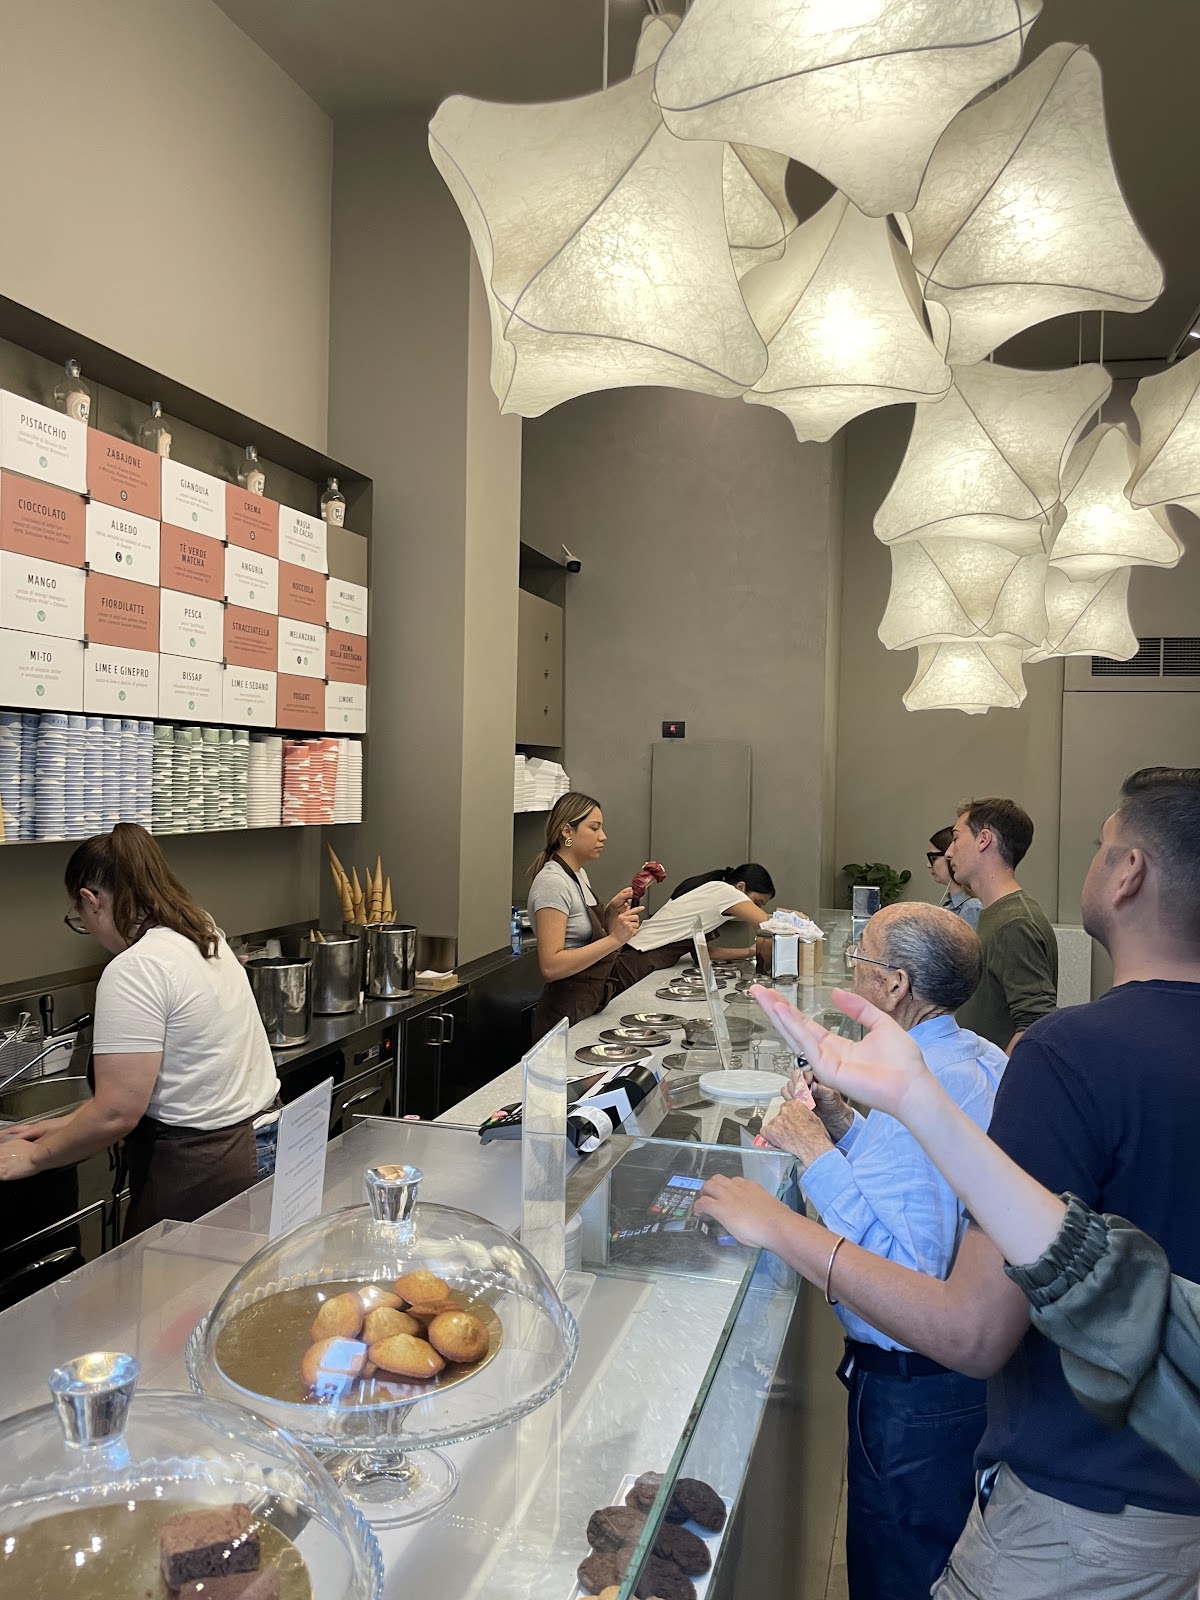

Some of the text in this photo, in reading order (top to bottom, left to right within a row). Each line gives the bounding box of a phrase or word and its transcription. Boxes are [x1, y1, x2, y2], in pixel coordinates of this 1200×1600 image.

[21, 414, 67, 440] PISTACCHIO
[107, 447, 141, 468] ZABAJONE
[181, 478, 209, 496] GIANDUIA
[18, 499, 66, 520] CIOCCOLATO
[244, 502, 261, 515] CREMA
[111, 520, 137, 535] ALBEDO
[296, 519, 310, 530] MASSA
[300, 528, 313, 539] CACAO
[189, 546, 207, 559] VERDE
[182, 554, 204, 567] MATCHA
[241, 562, 263, 575] ANGURIA
[27, 574, 57, 589] MANGO
[292, 582, 314, 594] NOCCIOLA
[101, 597, 145, 615] FIORDILATTE
[184, 608, 202, 619] PESCA
[232, 622, 269, 636] STRACCIATELLA
[289, 630, 316, 642] MELANZANA
[30, 650, 52, 662] MI-TO
[95, 662, 149, 678] LIME E GINEPRO
[182, 671, 202, 682] BISSAP
[231, 679, 244, 688] LIME
[249, 681, 269, 691] SEDANO
